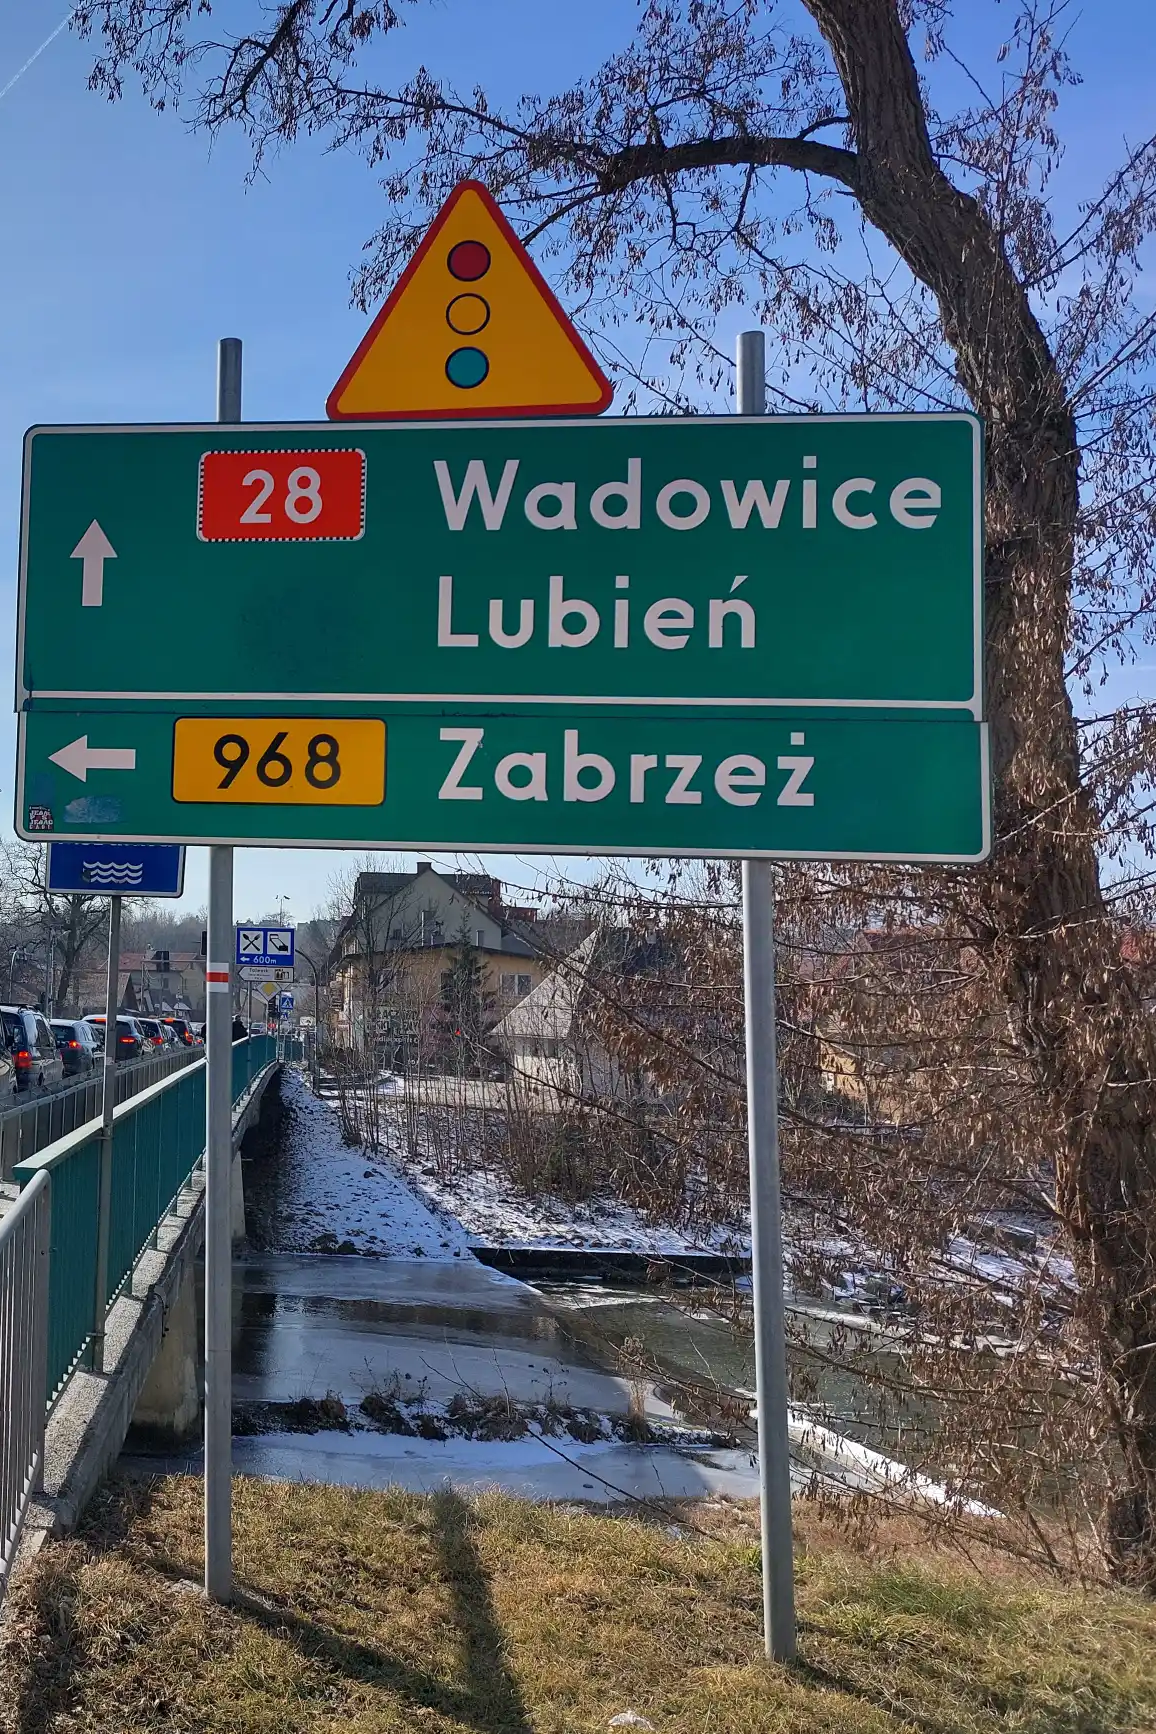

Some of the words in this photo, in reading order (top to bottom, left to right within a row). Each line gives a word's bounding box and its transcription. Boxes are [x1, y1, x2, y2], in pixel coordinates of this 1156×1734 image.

[239, 466, 323, 525] 28
[433, 455, 942, 532] Wadowice
[437, 575, 756, 650] Lubień
[213, 732, 342, 790] 968
[437, 727, 816, 807] Zabrzeż
